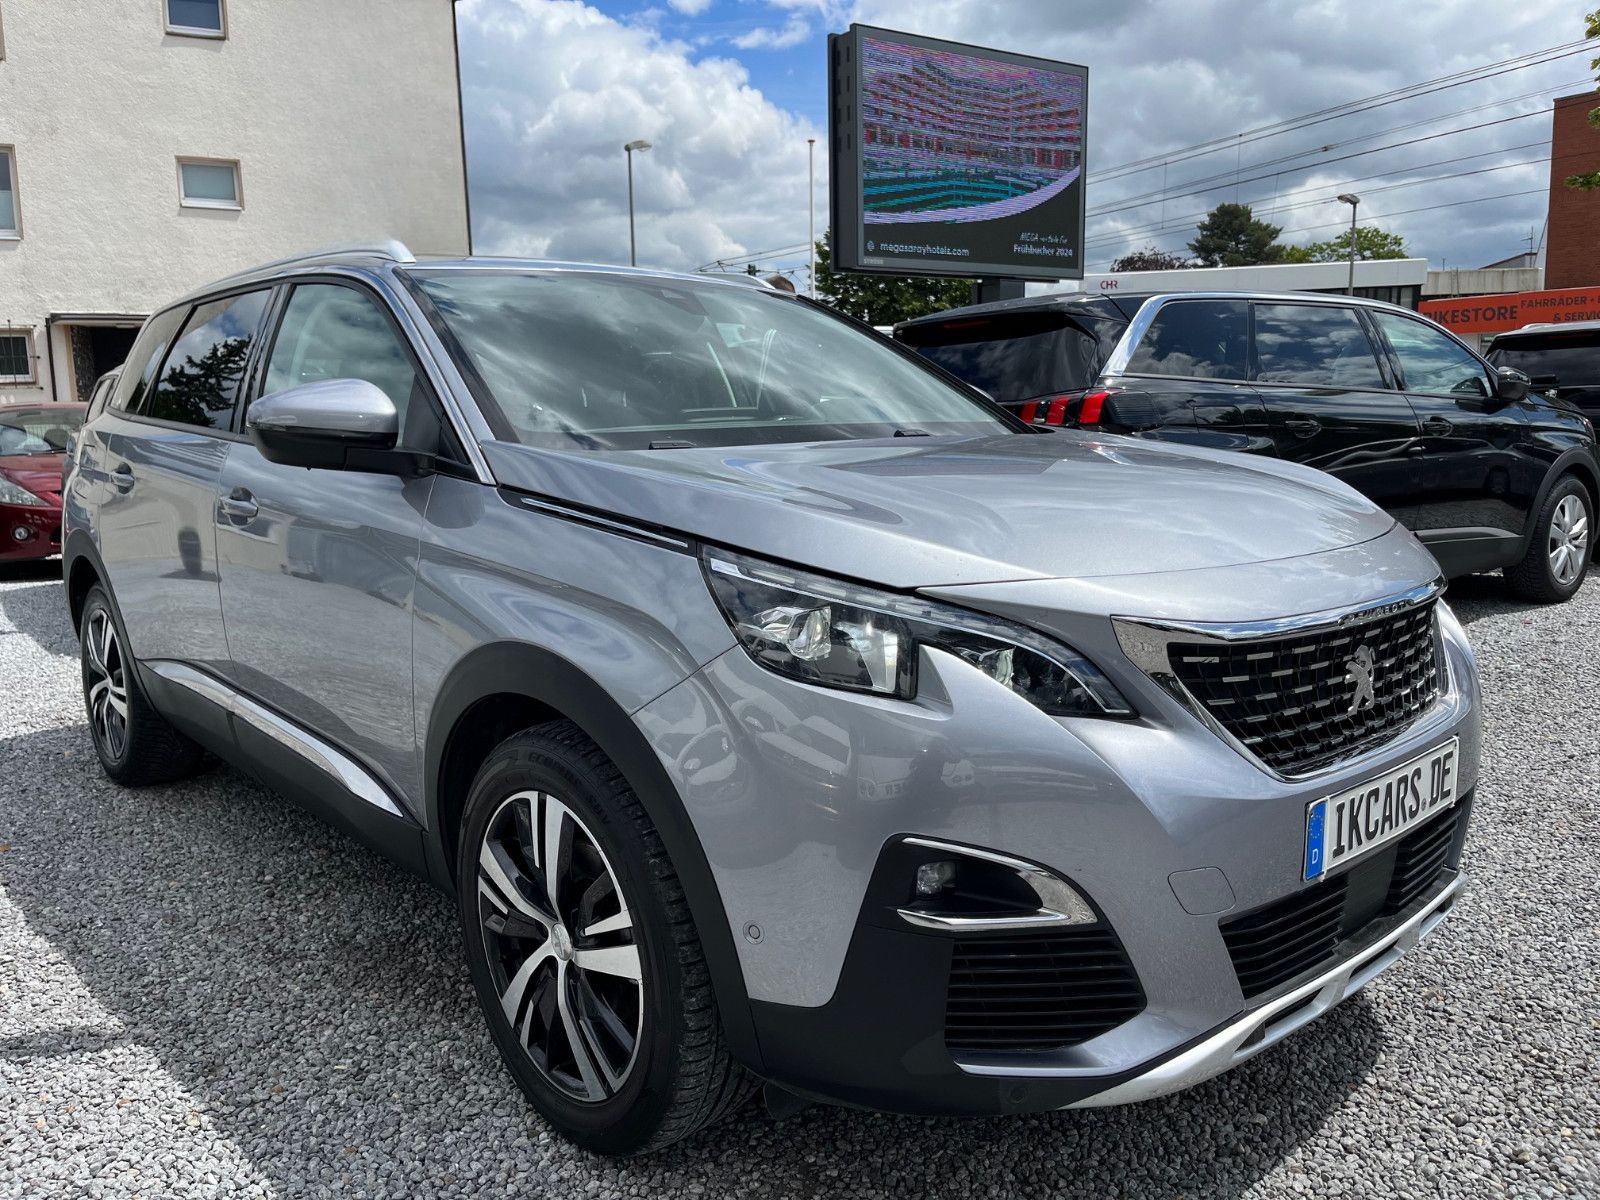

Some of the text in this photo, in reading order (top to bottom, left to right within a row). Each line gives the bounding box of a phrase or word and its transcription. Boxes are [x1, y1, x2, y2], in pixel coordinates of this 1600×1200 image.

[1100, 280, 1118, 290] CHR
[1520, 295, 1587, 309] FAHRRÄDER
[1553, 313, 1561, 321] &
[1311, 848, 1319, 864] D
